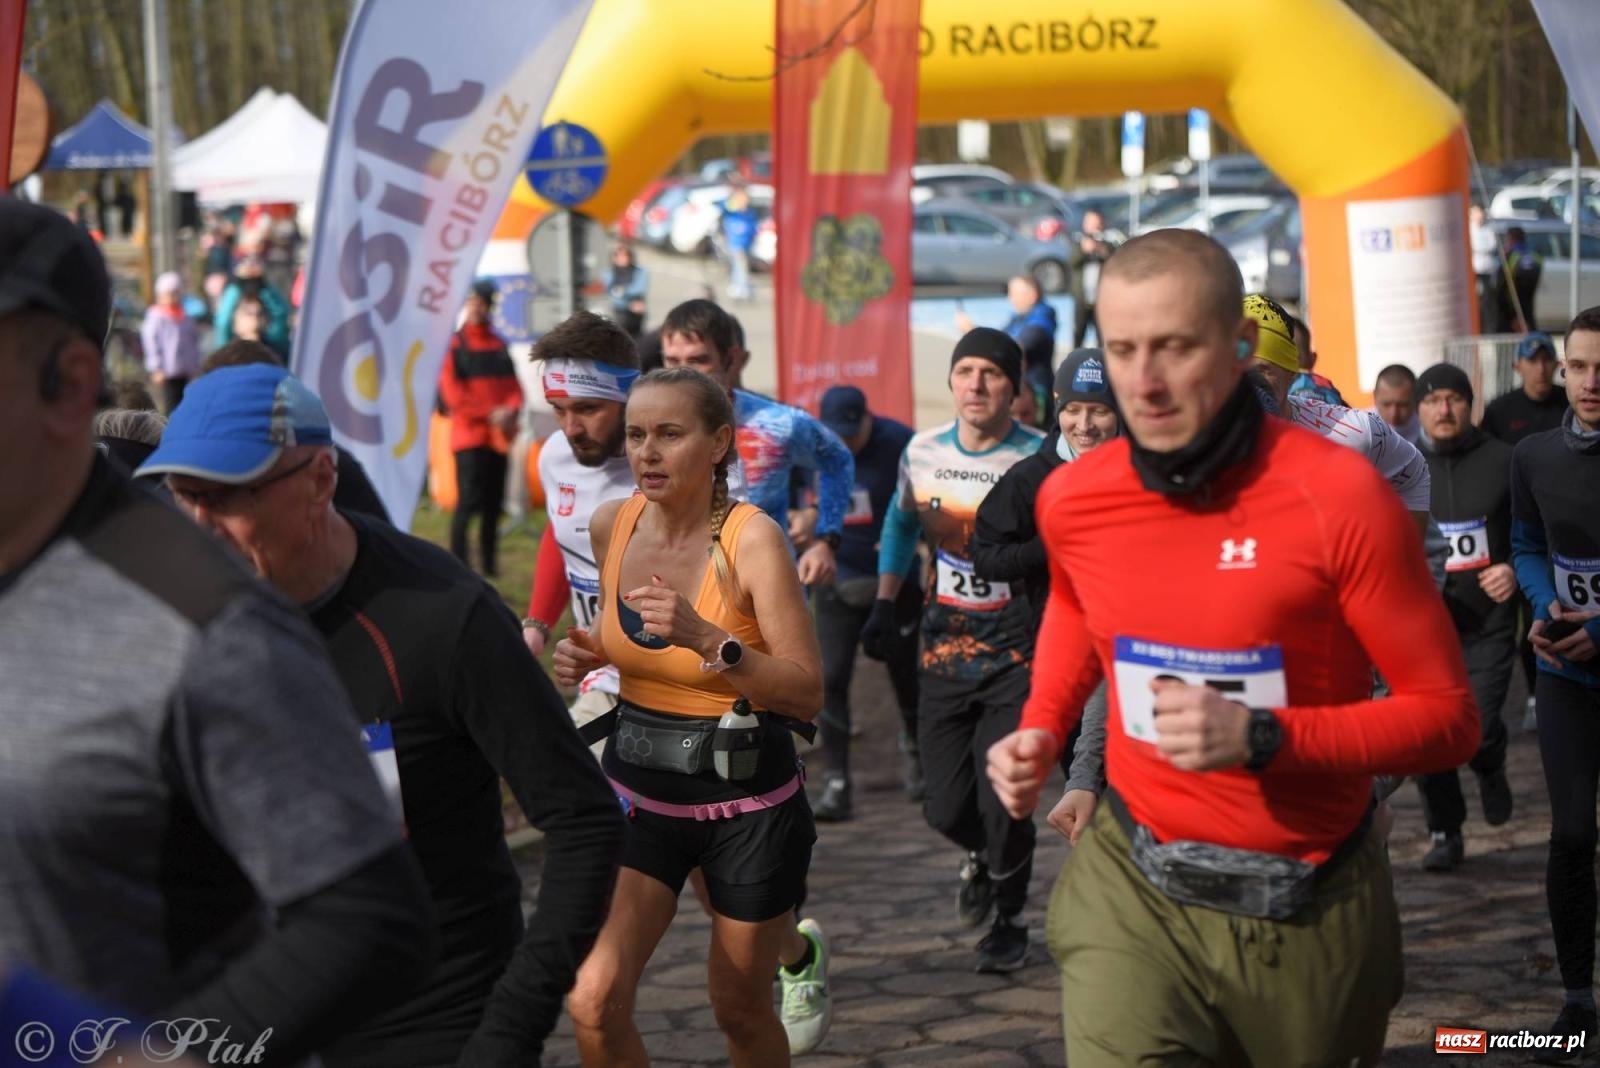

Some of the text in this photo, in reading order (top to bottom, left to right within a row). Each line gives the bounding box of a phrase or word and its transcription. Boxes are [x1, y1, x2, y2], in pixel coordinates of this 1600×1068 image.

[949, 9, 1160, 56] RACIBÓRZ
[418, 94, 529, 314] RACIBÓRZ
[951, 571, 992, 598] 25
